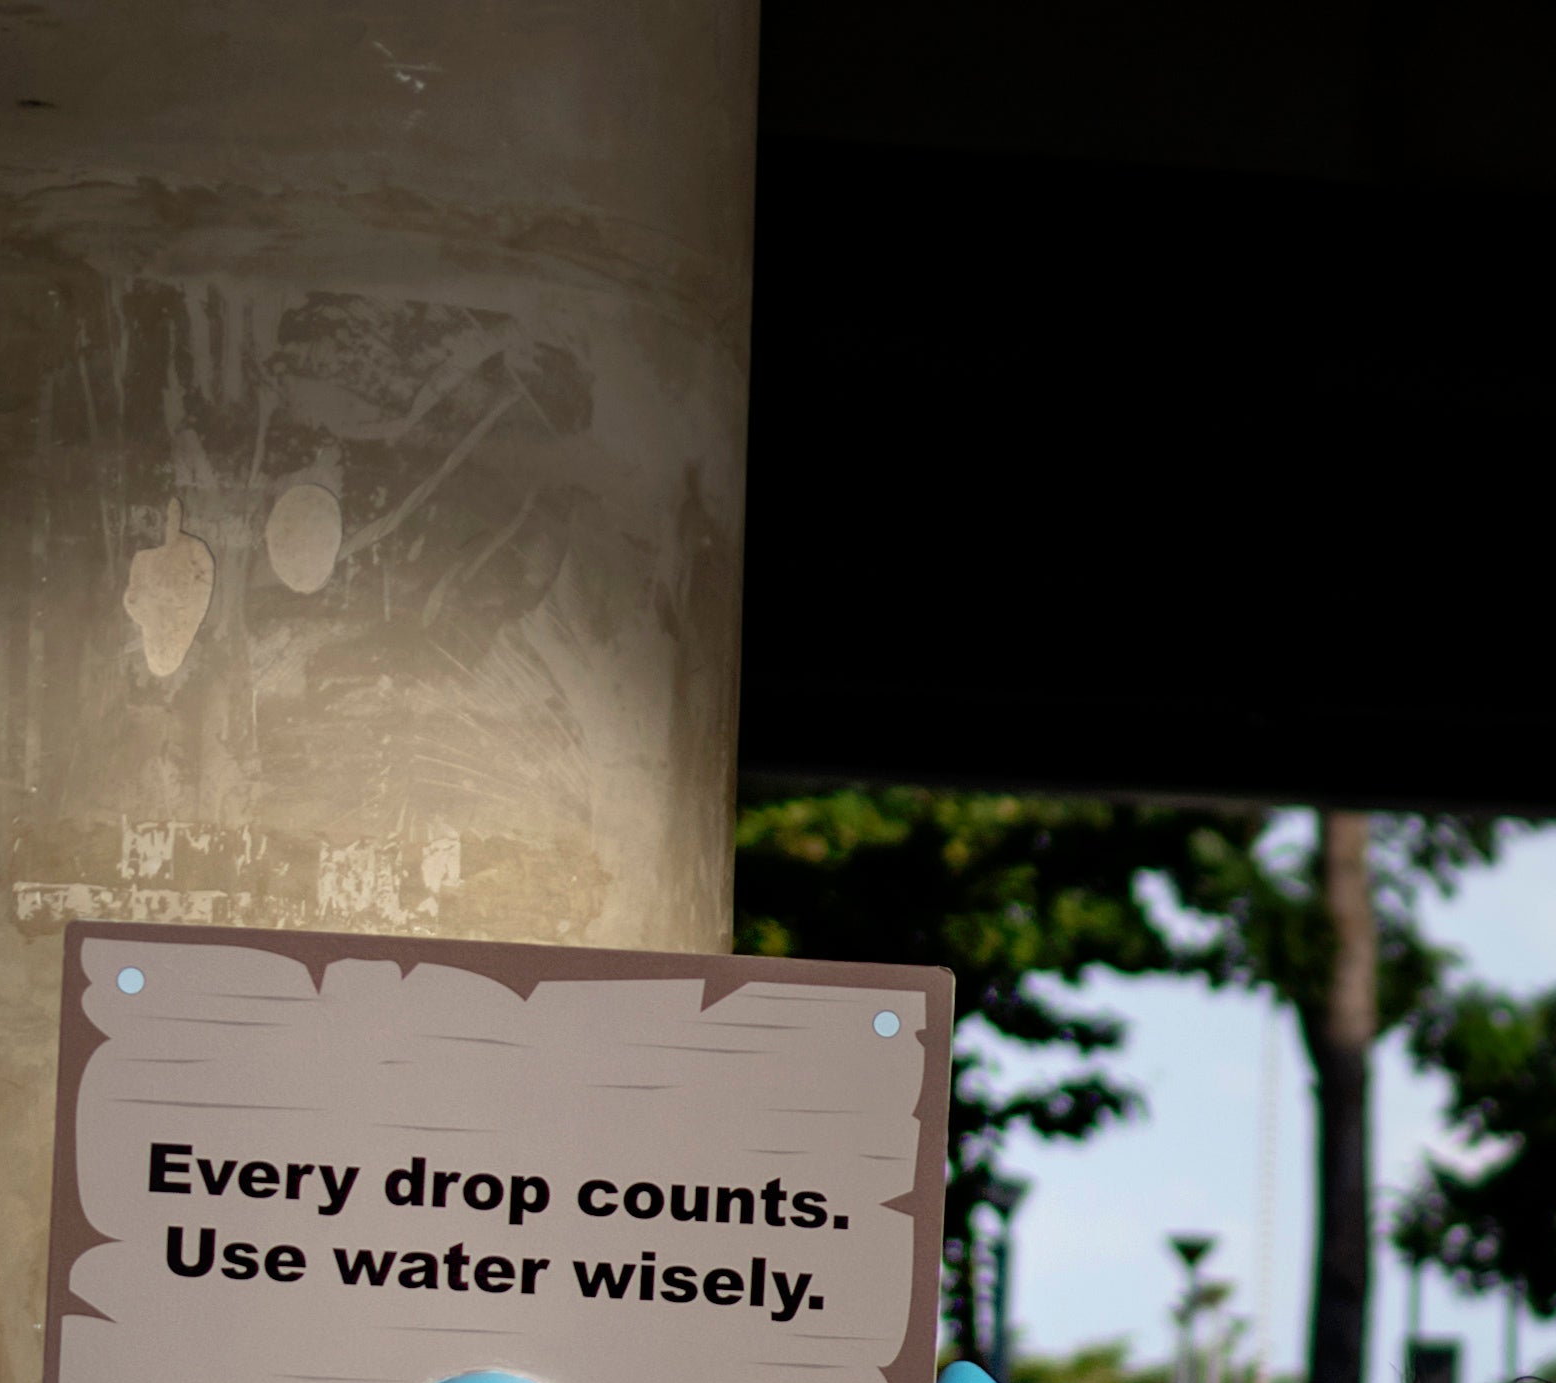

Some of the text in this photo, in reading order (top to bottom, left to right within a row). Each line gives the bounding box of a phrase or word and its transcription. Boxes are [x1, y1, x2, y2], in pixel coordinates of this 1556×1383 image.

[147, 1142, 850, 1231] Every drop counts.
[165, 1225, 825, 1324] Use water wisely.
